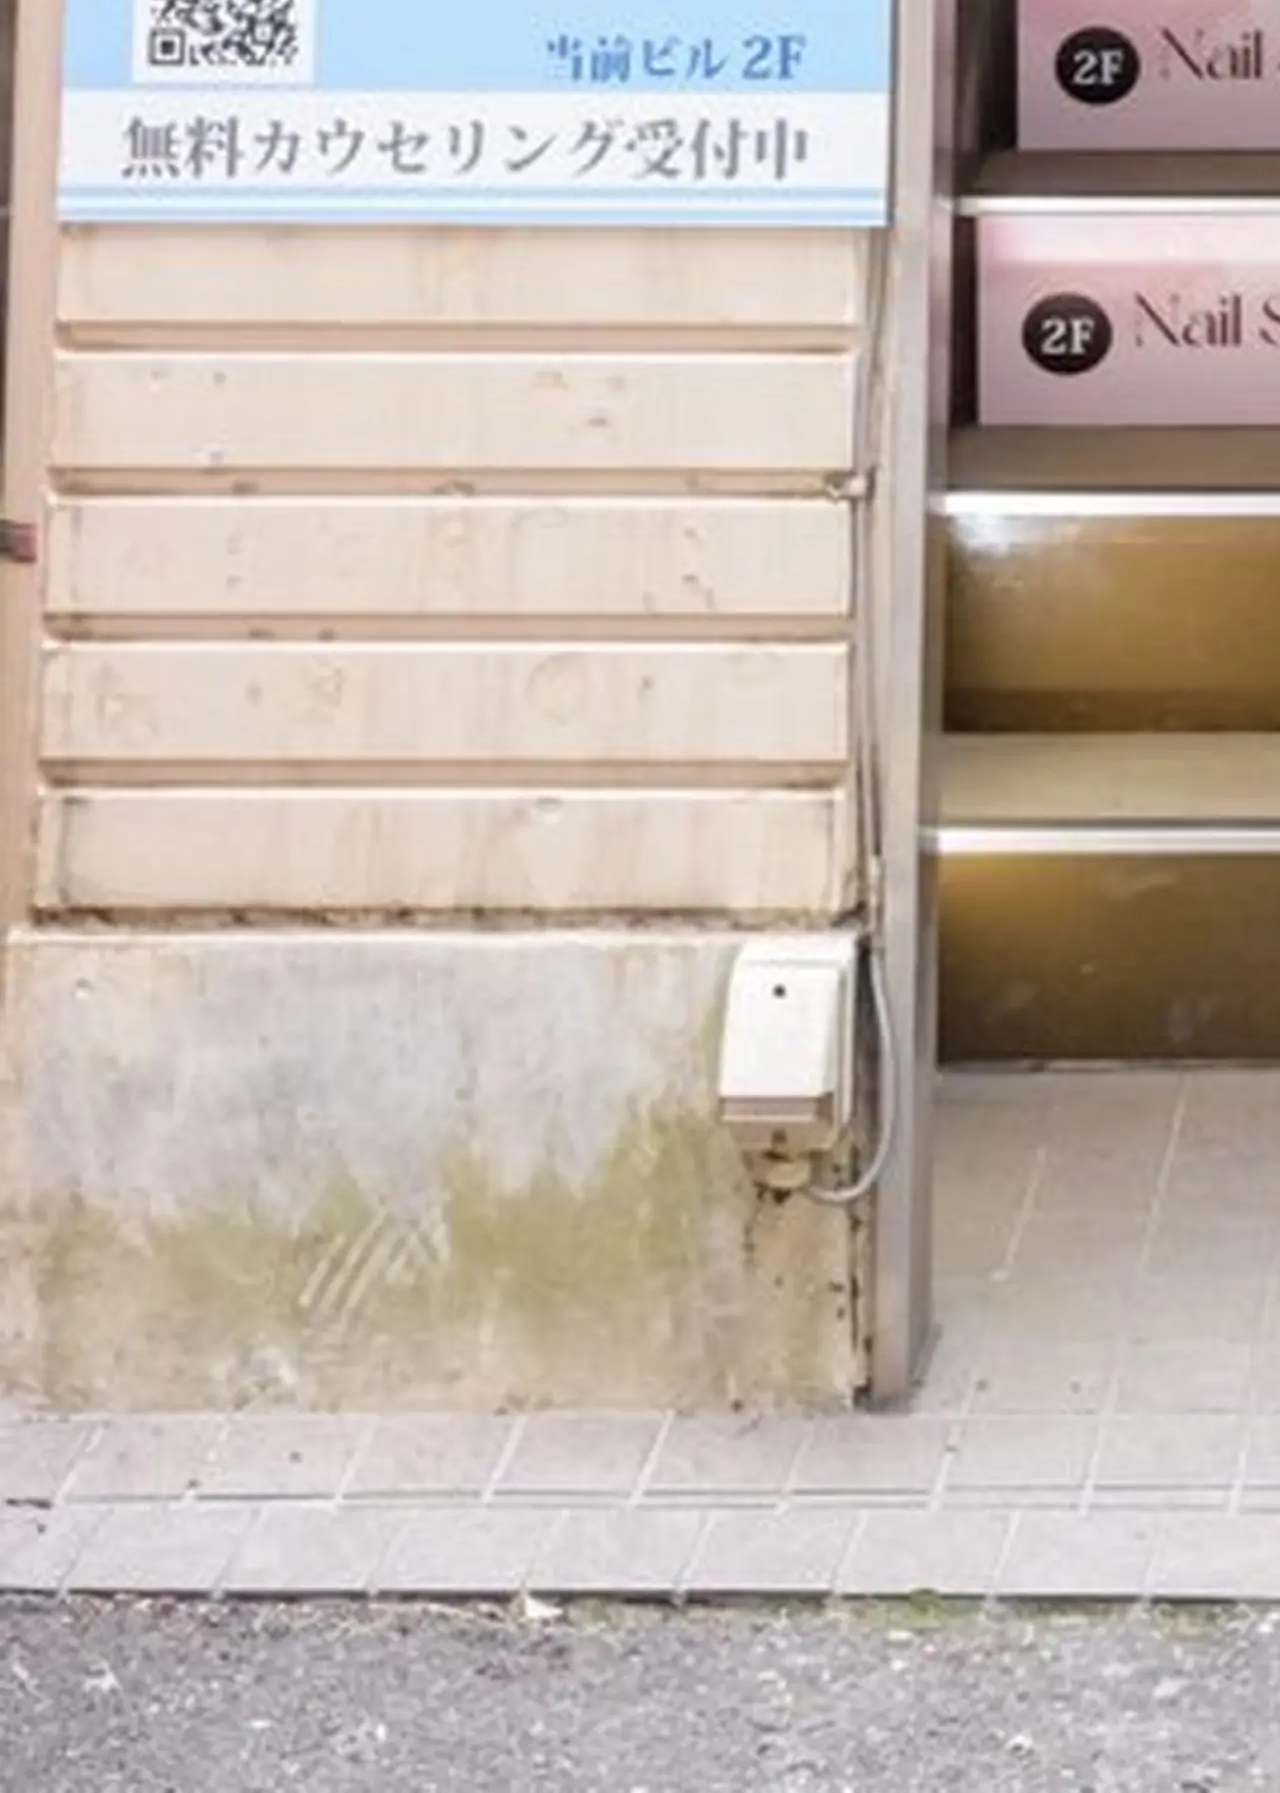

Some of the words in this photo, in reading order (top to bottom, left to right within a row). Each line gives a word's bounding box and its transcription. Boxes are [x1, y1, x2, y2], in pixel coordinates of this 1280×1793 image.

[1072, 48, 1126, 86] 2F
[1162, 29, 1262, 79] Nail
[122, 116, 807, 179] 無料カウセリング受付中
[1043, 317, 1094, 360] 2F
[1136, 295, 1241, 347] Nail
